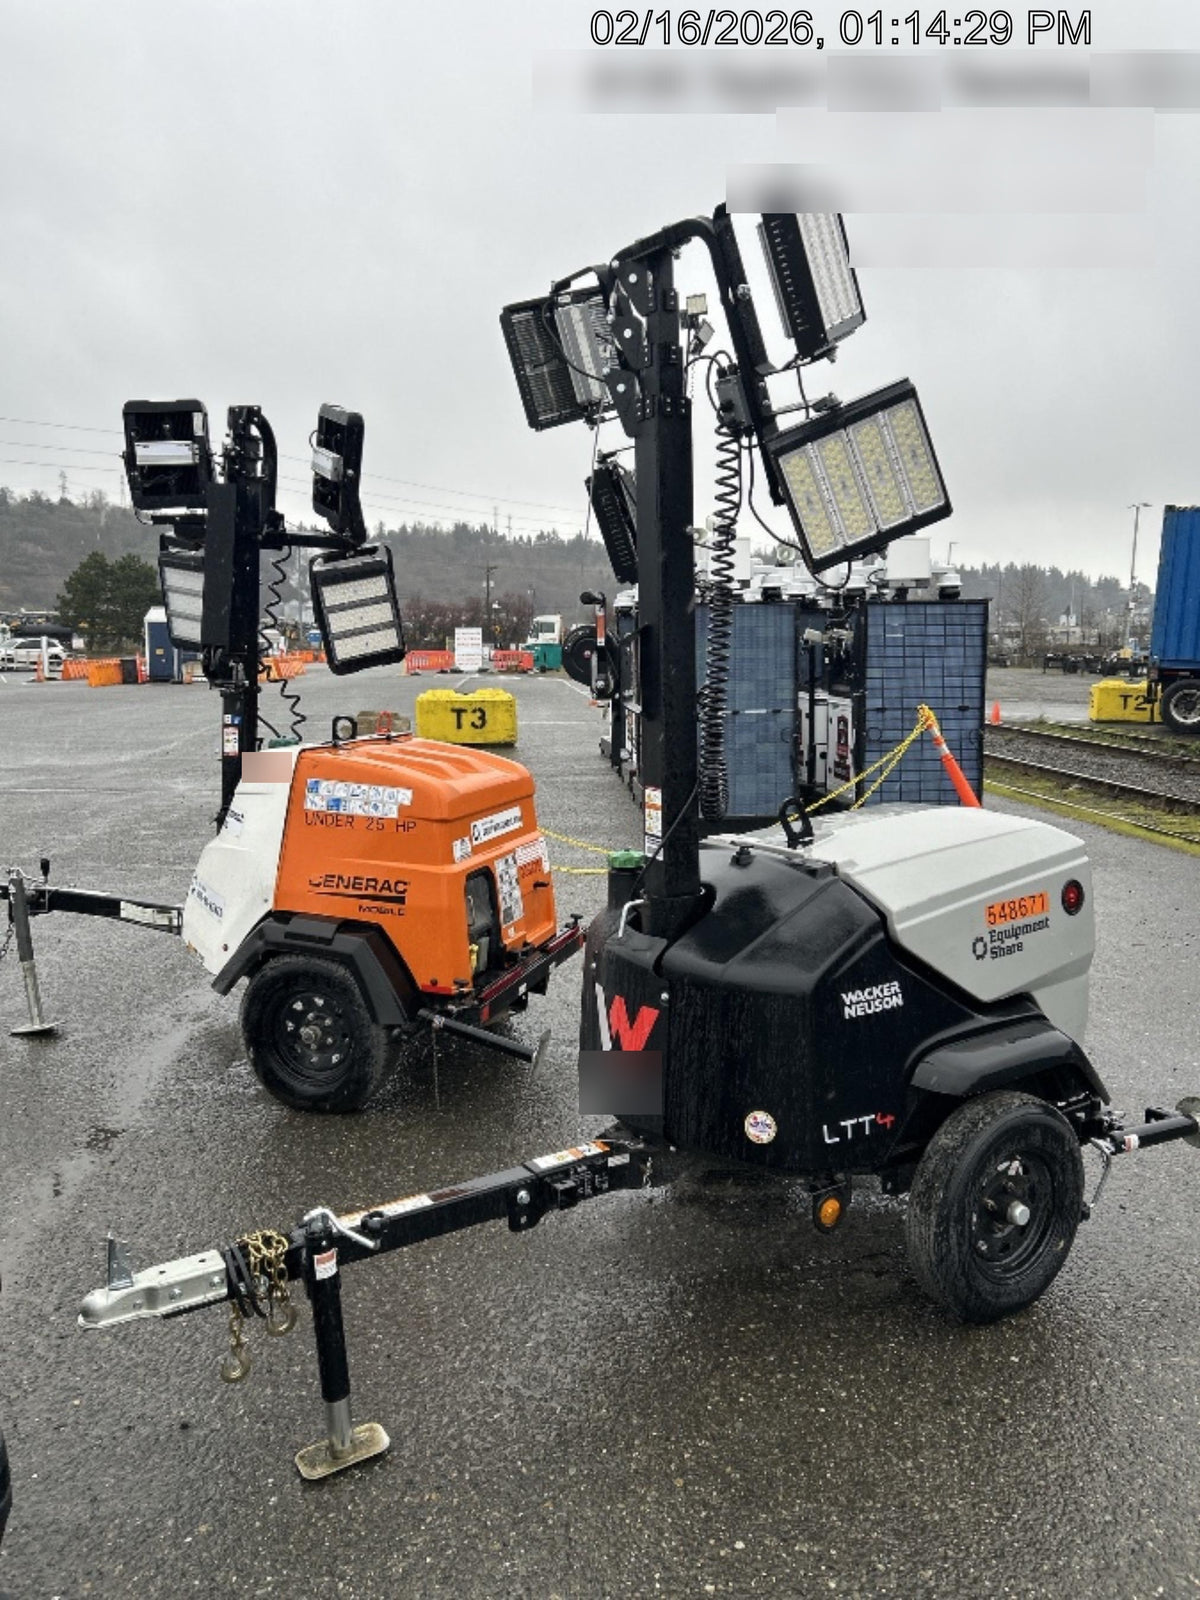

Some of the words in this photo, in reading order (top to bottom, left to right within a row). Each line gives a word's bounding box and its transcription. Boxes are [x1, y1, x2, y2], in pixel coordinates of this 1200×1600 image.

[1119, 694, 1148, 711] T2
[450, 706, 487, 730] T3
[304, 811, 355, 829] UNDER
[366, 816, 385, 831] 25
[395, 819, 417, 833] HP
[987, 893, 1046, 926] 548671
[988, 917, 1050, 946] Equipment
[989, 941, 1024, 961] Share
[840, 981, 901, 1005] WACKER
[844, 994, 904, 1019] NEUSON
[822, 1112, 895, 1145] LTT4
